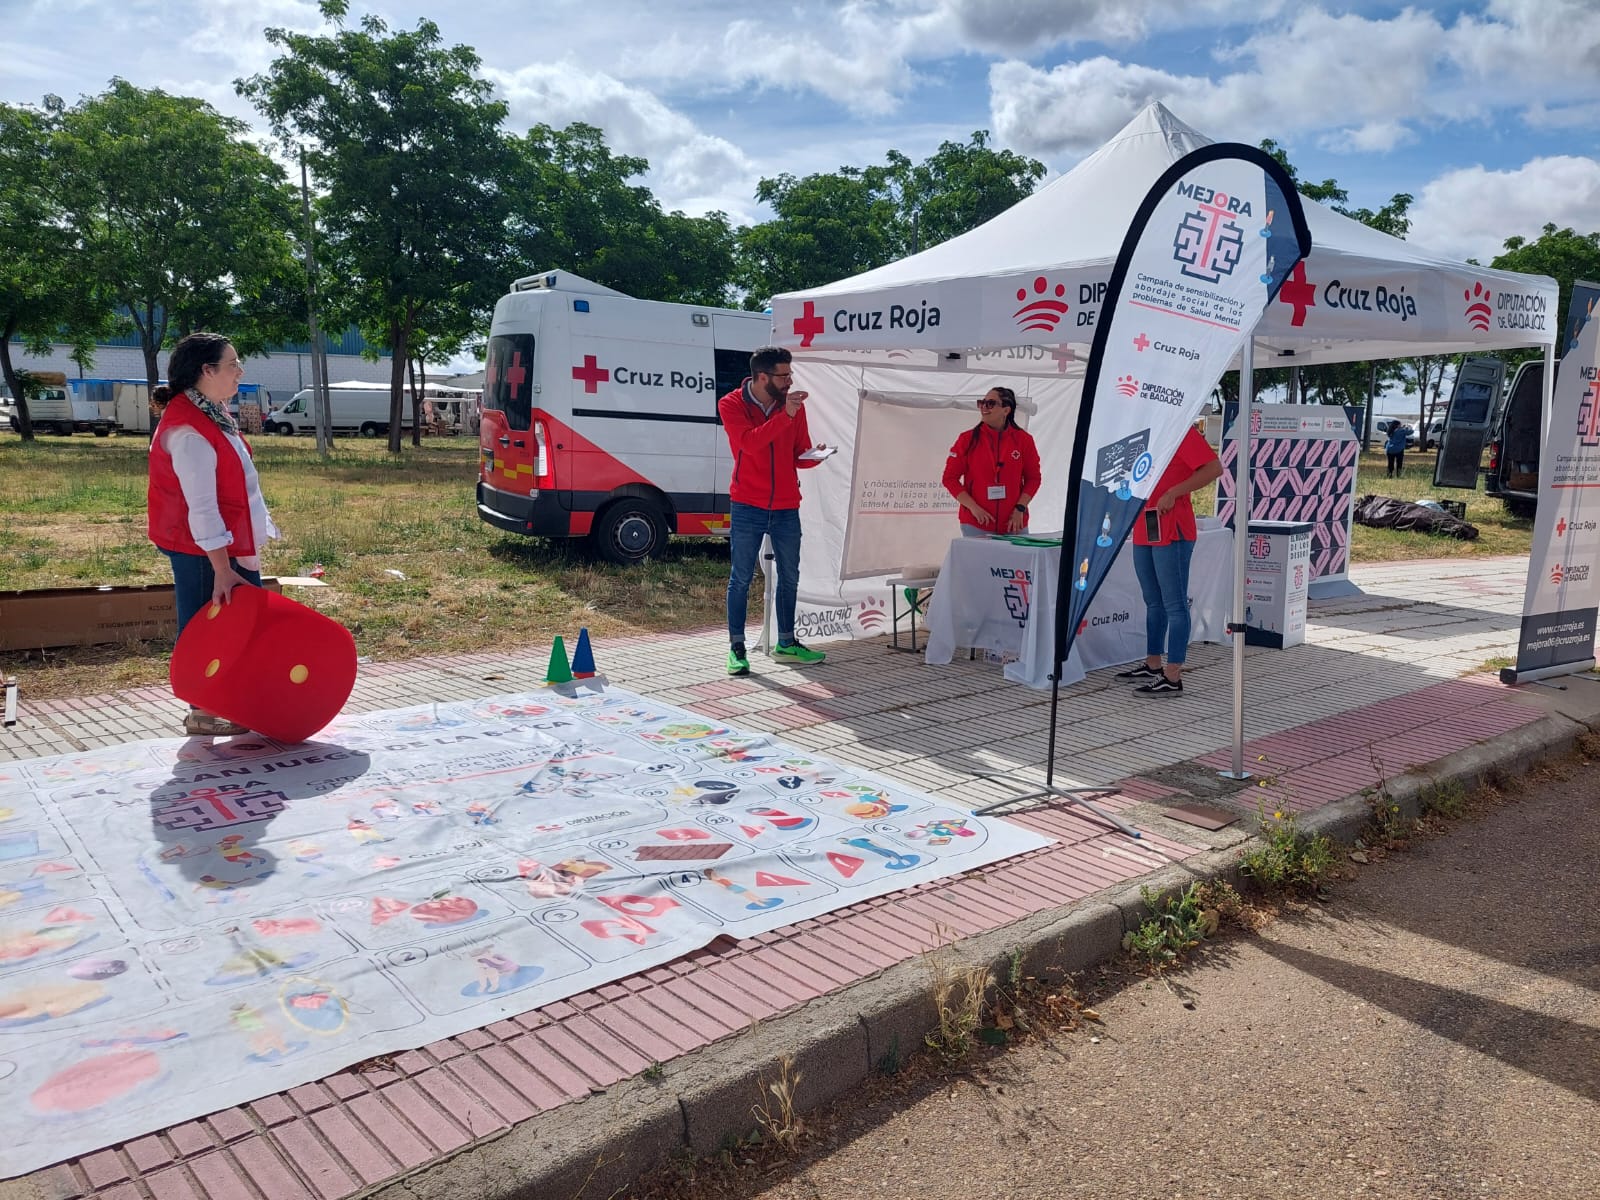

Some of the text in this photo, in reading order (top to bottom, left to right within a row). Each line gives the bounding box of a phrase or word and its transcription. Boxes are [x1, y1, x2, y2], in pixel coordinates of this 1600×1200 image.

[1176, 181, 1252, 217] MEJORA
[1079, 281, 1108, 305] DIP
[1134, 283, 1243, 317] abordaje social de los
[1137, 273, 1246, 309] Campaña de sensibilización y
[1324, 279, 1417, 322] Cruz Roja
[1132, 292, 1241, 326] problemas de Salud Mental
[1497, 290, 1546, 312] DIPUTACIÓN
[833, 300, 941, 334] Cruz Roja
[1076, 311, 1095, 327] DE
[1497, 313, 1545, 331] DE BADAJOZ
[1153, 341, 1200, 360] Cruz Roja
[613, 367, 715, 394] Cruz Roja
[1140, 391, 1183, 407] DE BADAJOZ
[1141, 382, 1184, 399] DIPUTACIÓN
[1569, 520, 1597, 532] Cruz Roja
[1091, 611, 1130, 627] Cruz Roja
[1536, 620, 1585, 636] www.cruzroja.es
[133, 767, 252, 790] GRAN
[434, 735, 479, 745] LA
[603, 840, 622, 849] 27
[681, 874, 691, 884] 4
[403, 951, 416, 961] 2
